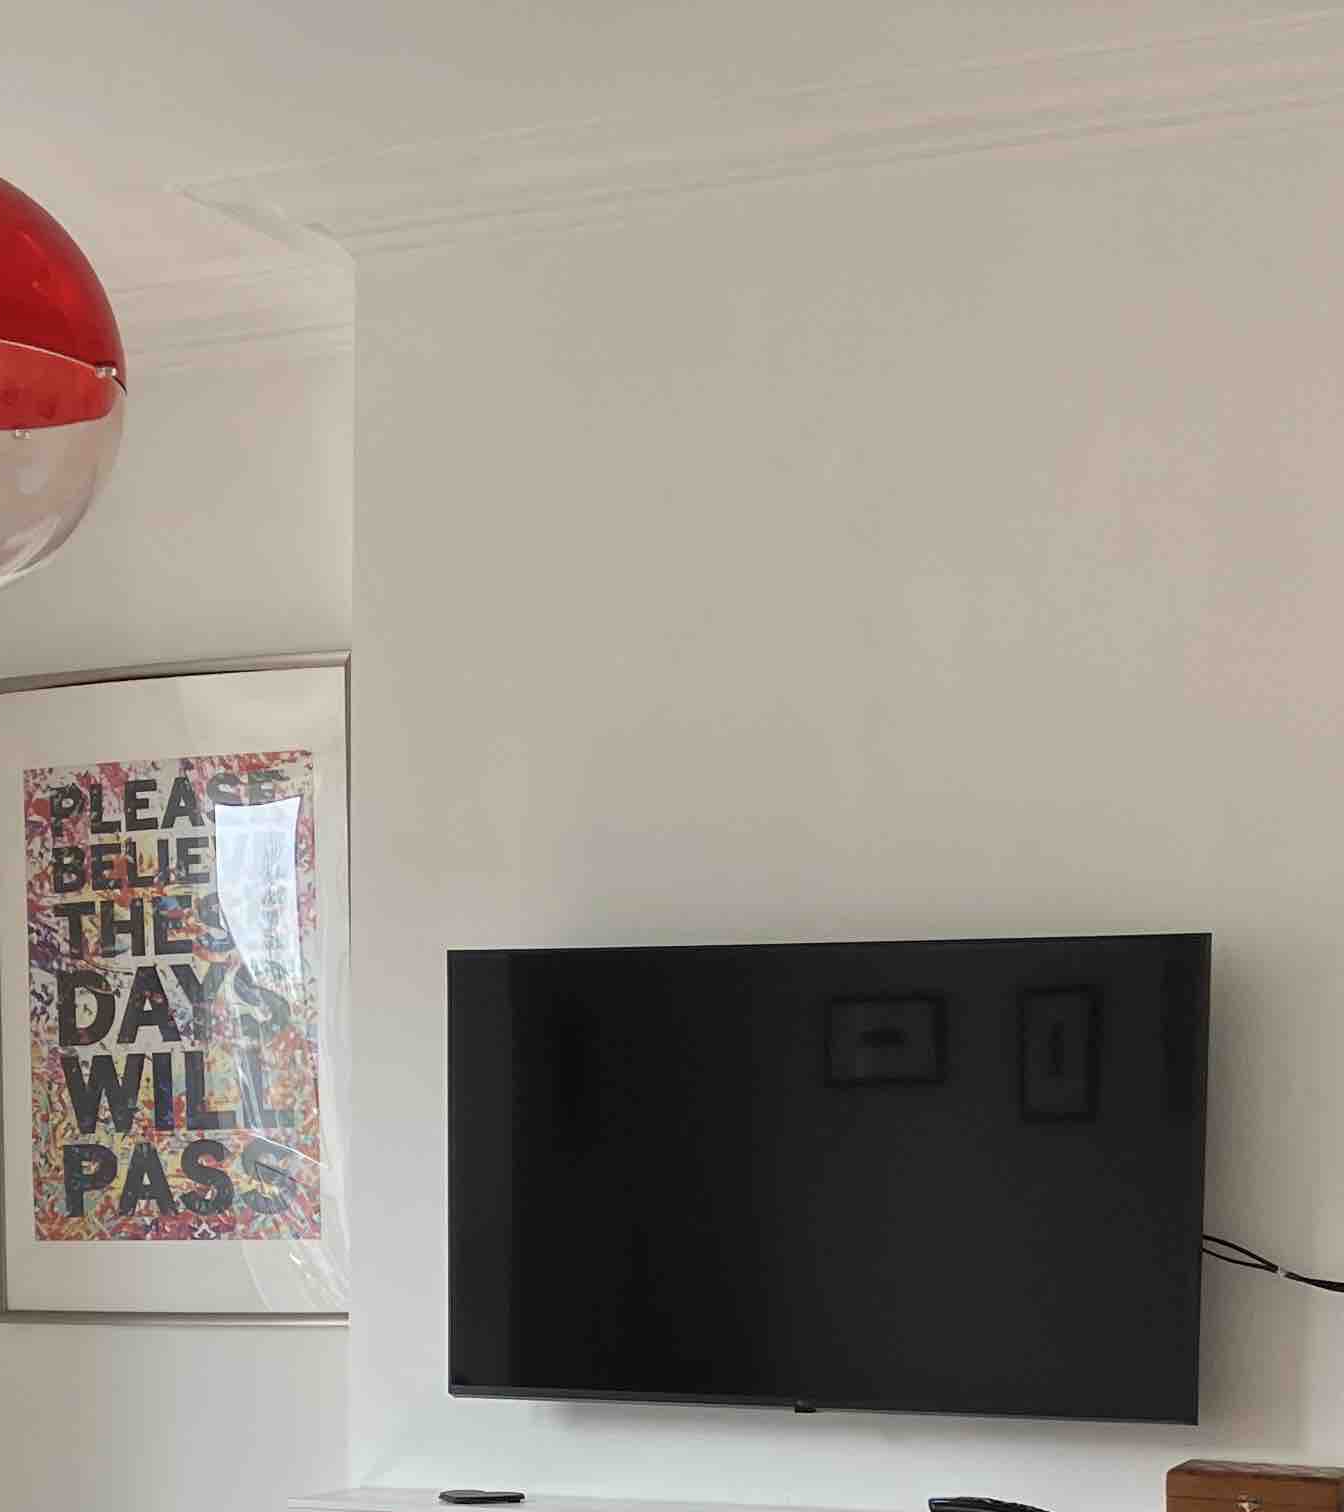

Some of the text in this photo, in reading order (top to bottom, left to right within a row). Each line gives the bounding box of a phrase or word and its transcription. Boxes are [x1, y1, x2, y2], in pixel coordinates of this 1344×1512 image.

[51, 837, 216, 893] BELIE
[53, 895, 244, 960] THES
[57, 961, 291, 1047] DAYS
[60, 1050, 296, 1134] WILL
[62, 1138, 299, 1218] PASS
